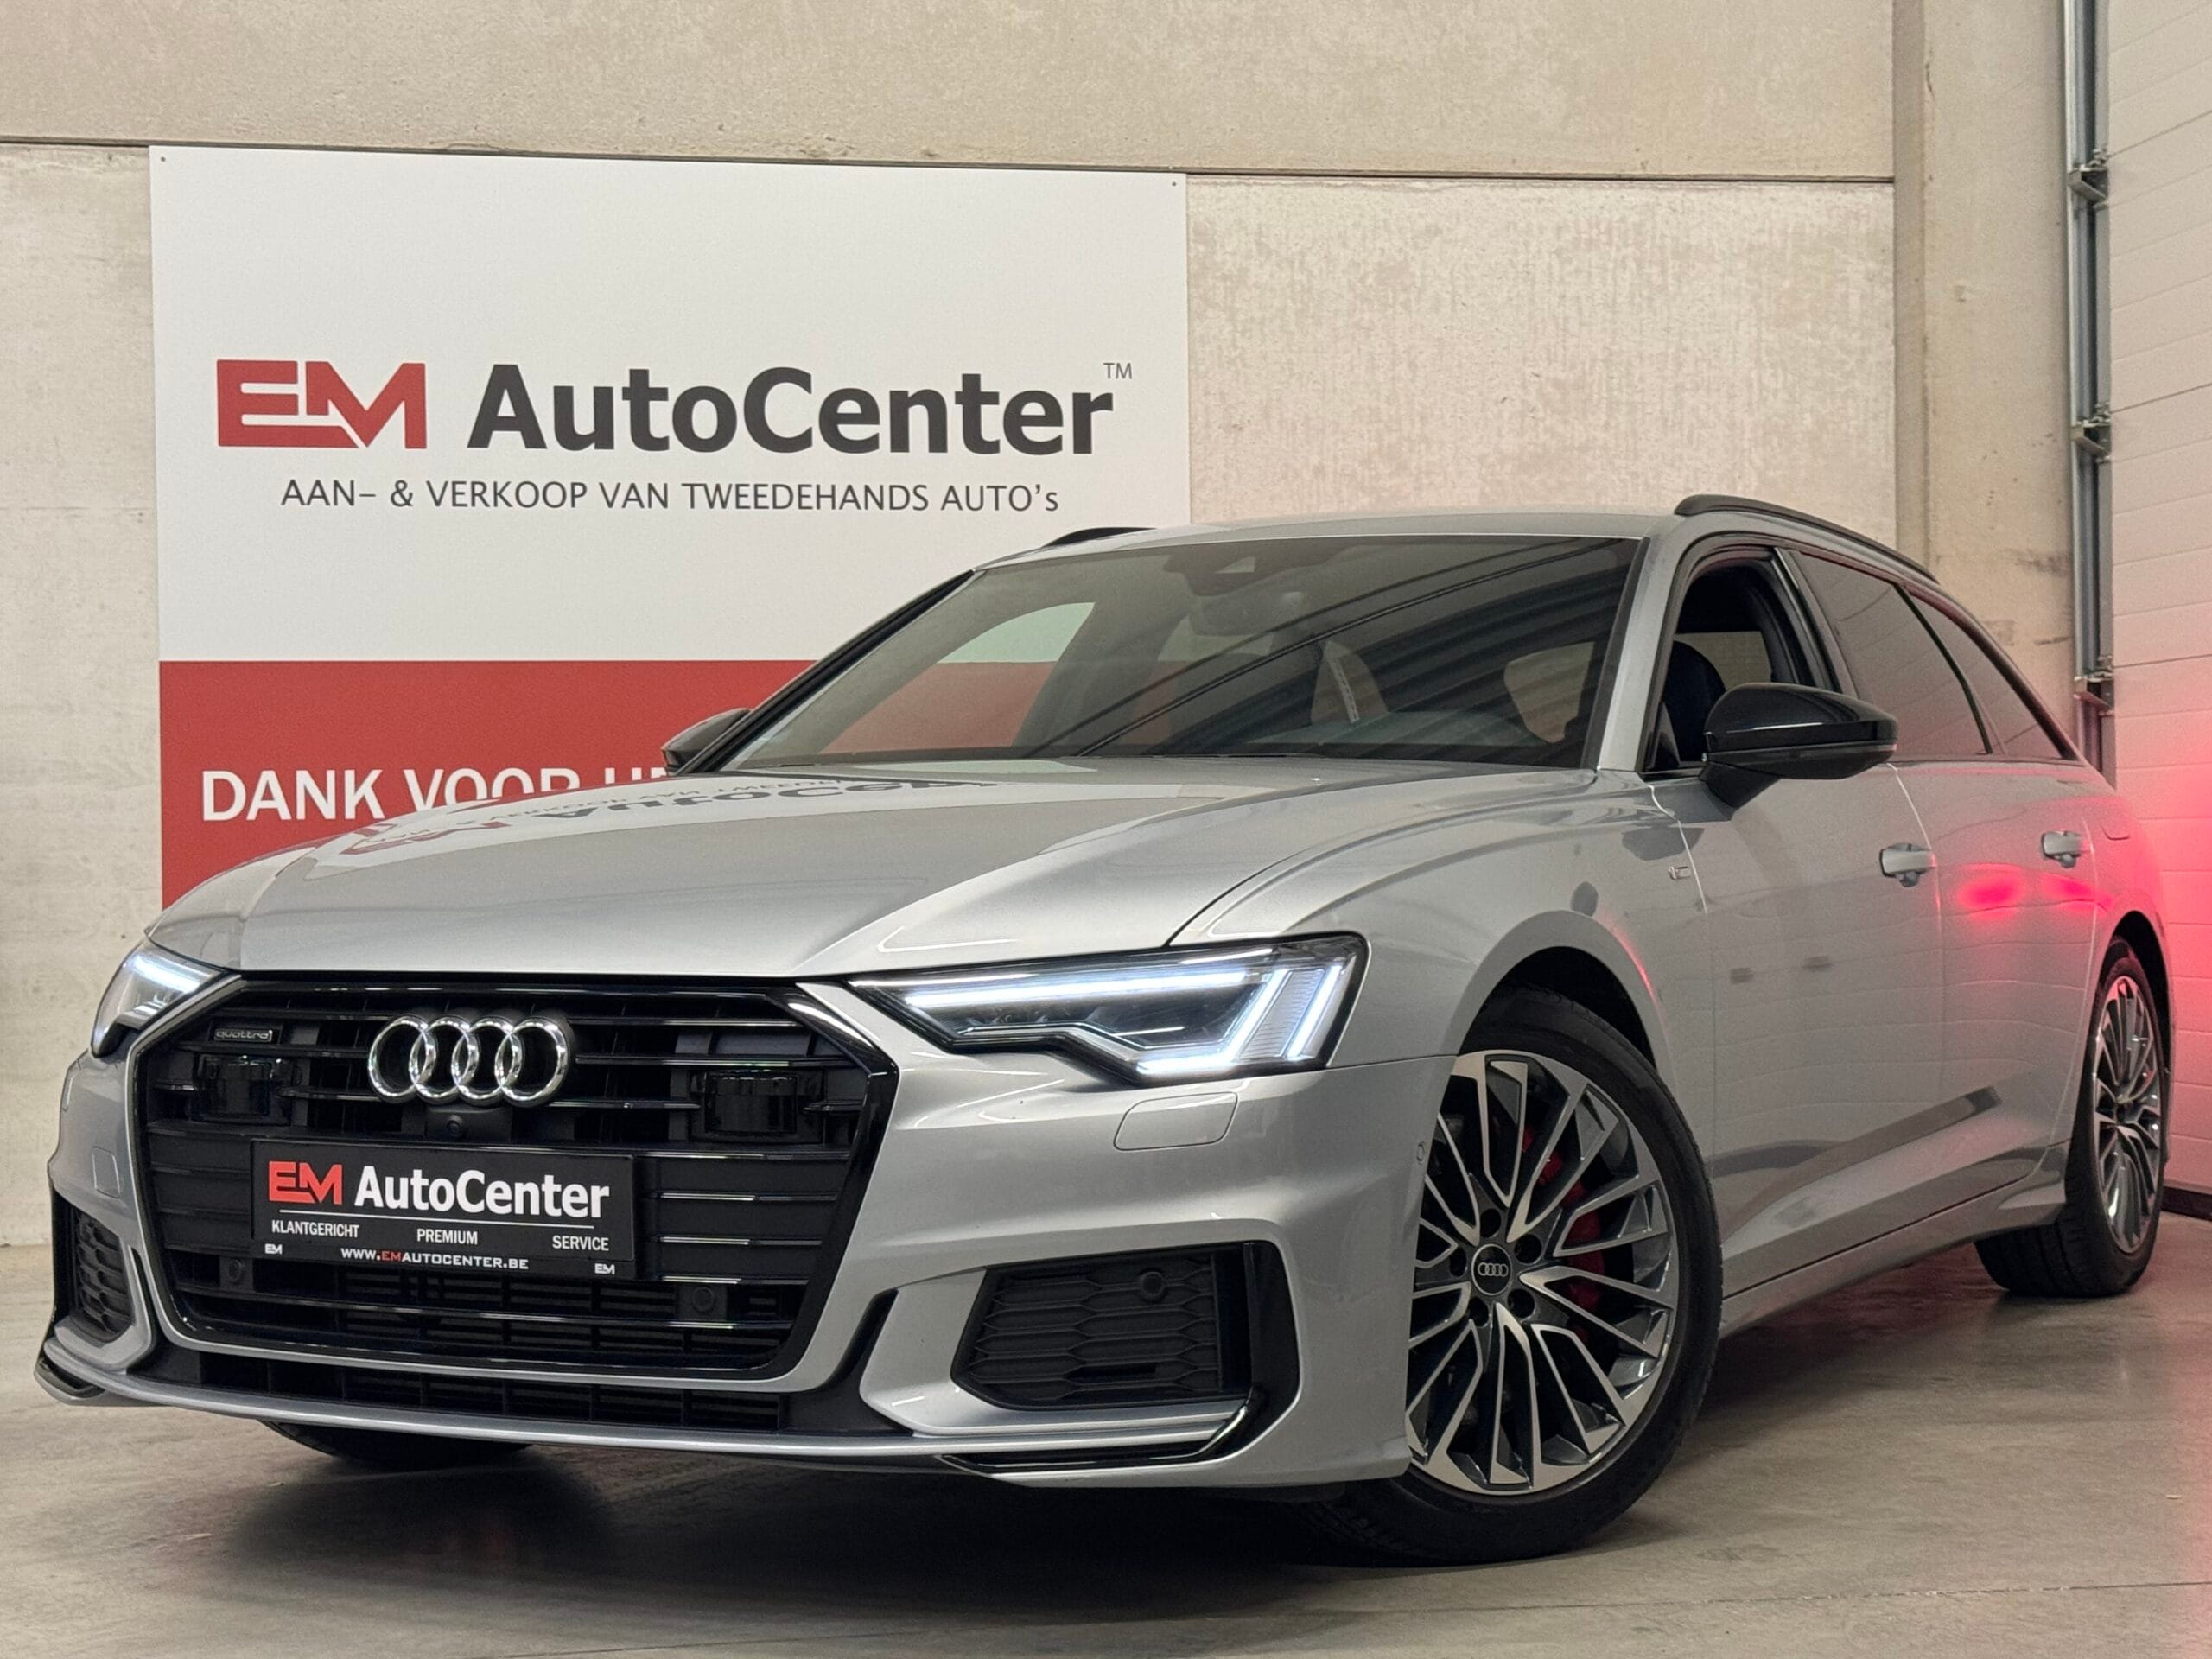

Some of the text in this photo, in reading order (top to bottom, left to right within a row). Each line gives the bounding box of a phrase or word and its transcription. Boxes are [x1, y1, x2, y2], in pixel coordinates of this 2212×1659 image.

[216, 359, 427, 449] EM
[467, 363, 1114, 456] AutoCenter
[390, 480, 414, 507] &
[426, 480, 588, 508] VERKOOP
[598, 482, 669, 509] VAN
[681, 483, 929, 511] TWEEDEHANDS
[940, 484, 1058, 512] AUTO's
[201, 769, 385, 821] DANK
[215, 1028, 270, 1040] quattro
[267, 1160, 610, 1218] EM AutoCenter
[271, 1219, 610, 1251] KLANTGERICHT PREMIUM SERVICE
[340, 1247, 529, 1270] WWW.EMAUTOCENTER.BE
